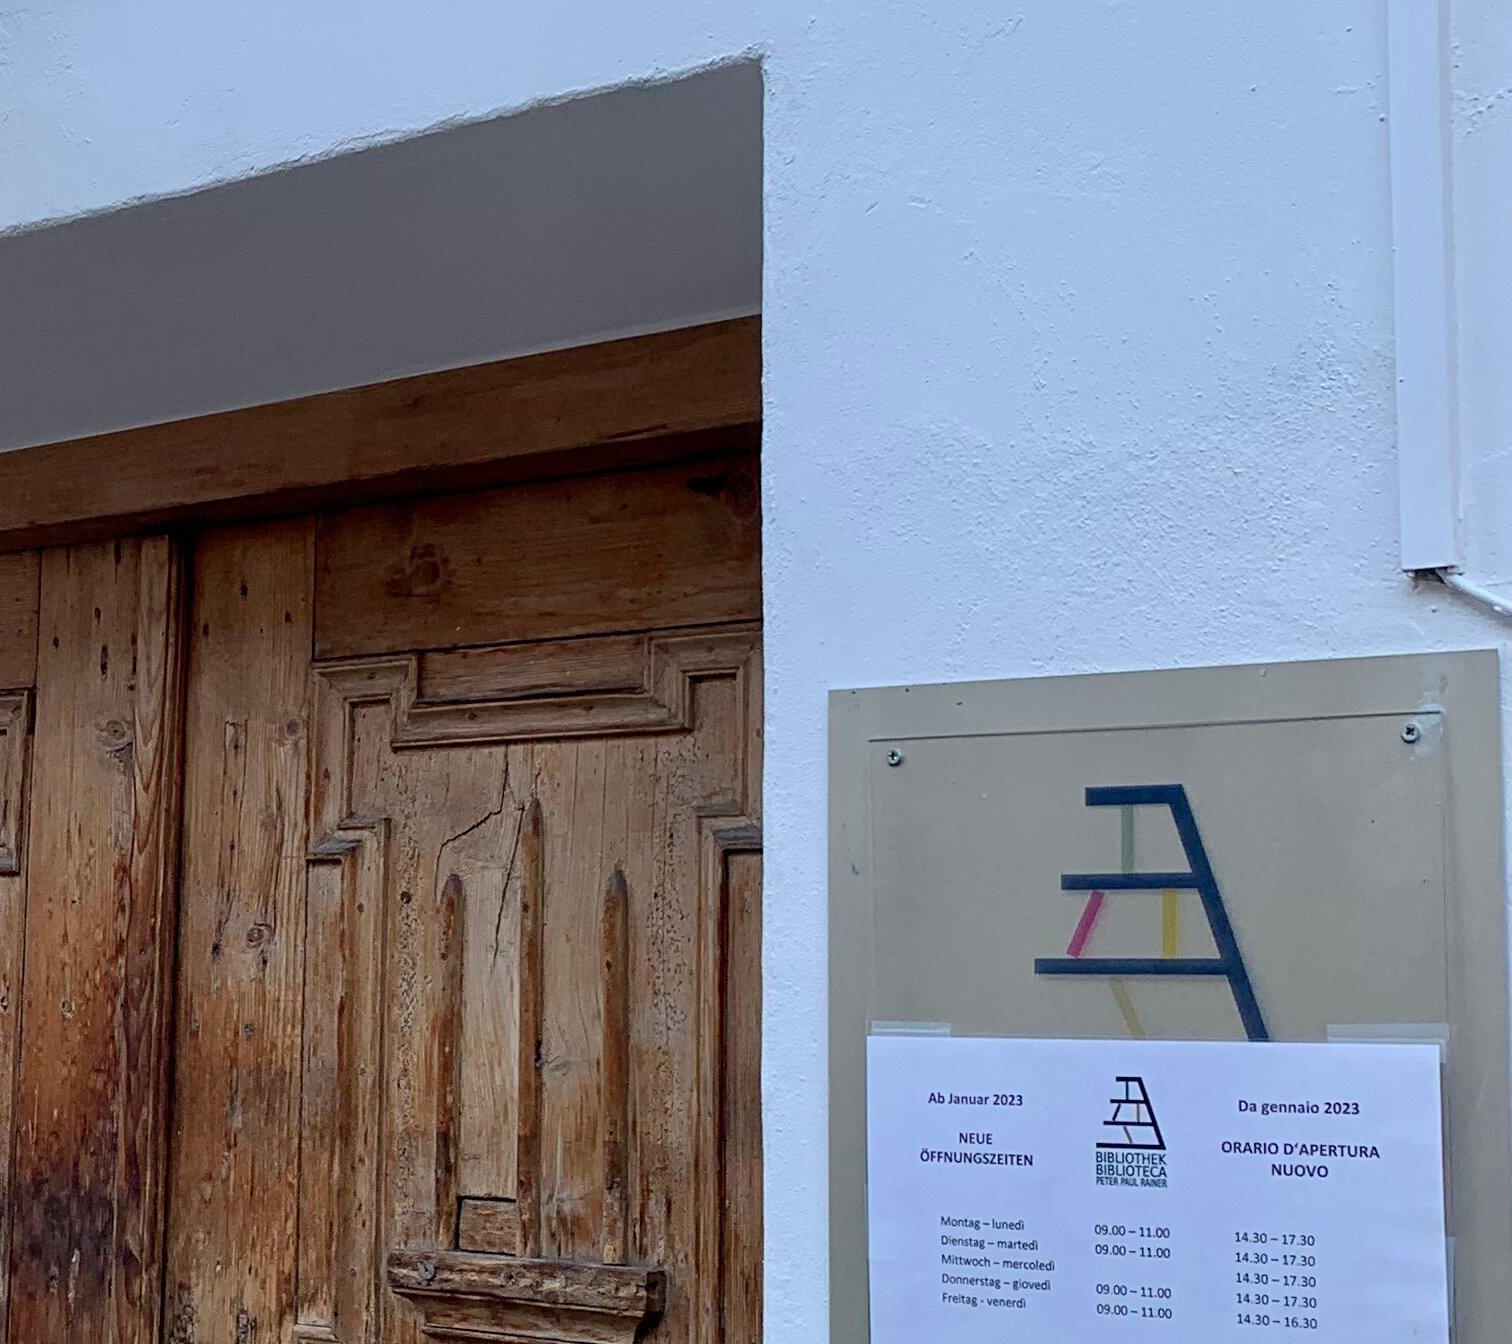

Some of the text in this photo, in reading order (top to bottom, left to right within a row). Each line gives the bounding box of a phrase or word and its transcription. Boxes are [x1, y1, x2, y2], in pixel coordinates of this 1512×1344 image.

[928, 1093, 1023, 1106] Ab Januar 2023
[1238, 1100, 1360, 1115] Da gennaio 2023
[959, 1132, 993, 1145] NEUE
[1221, 1141, 1279, 1155] ORARIO
[920, 1147, 1033, 1166] ÖFFNUNGSZEITEN
[1096, 1151, 1167, 1165] BIBLIOTHEK
[1096, 1164, 1167, 1177] BIBLIOTECA
[1271, 1164, 1329, 1178] NUOVO
[1096, 1176, 1168, 1188] PETER PAUL RAINER
[940, 1216, 980, 1230] Montag
[992, 1218, 1025, 1230] lunedì
[1094, 1224, 1126, 1236] 09.00
[1139, 1226, 1170, 1238] 11.00
[941, 1235, 985, 1249] Dienstag
[997, 1238, 1038, 1250] martedì
[1235, 1232, 1268, 1244] 14.30
[1282, 1234, 1315, 1246] 17.30
[1095, 1244, 1126, 1256] 09.00
[1139, 1246, 1171, 1258] 11.00
[941, 1254, 991, 1267] Mittwoch
[1002, 1258, 1055, 1271] mercoledì
[1235, 1252, 1268, 1264] 14.30
[1282, 1254, 1316, 1267] 17.30
[942, 1273, 1001, 1289] Donnerstag
[1012, 1277, 1051, 1291] giovedì
[1236, 1272, 1269, 1285] 14.30
[1283, 1275, 1316, 1287] 17.30
[1096, 1284, 1127, 1296] 09.00
[1140, 1286, 1172, 1299] 11.00
[942, 1292, 978, 1307] Freitag
[986, 1296, 1026, 1308] venerdì
[1236, 1293, 1269, 1305] 14.30
[1284, 1296, 1317, 1308] 17.30
[1096, 1303, 1128, 1316] 09.00
[1141, 1306, 1172, 1319] 11.00
[1237, 1314, 1270, 1326] 14.30
[1284, 1317, 1318, 1329] 16.30
